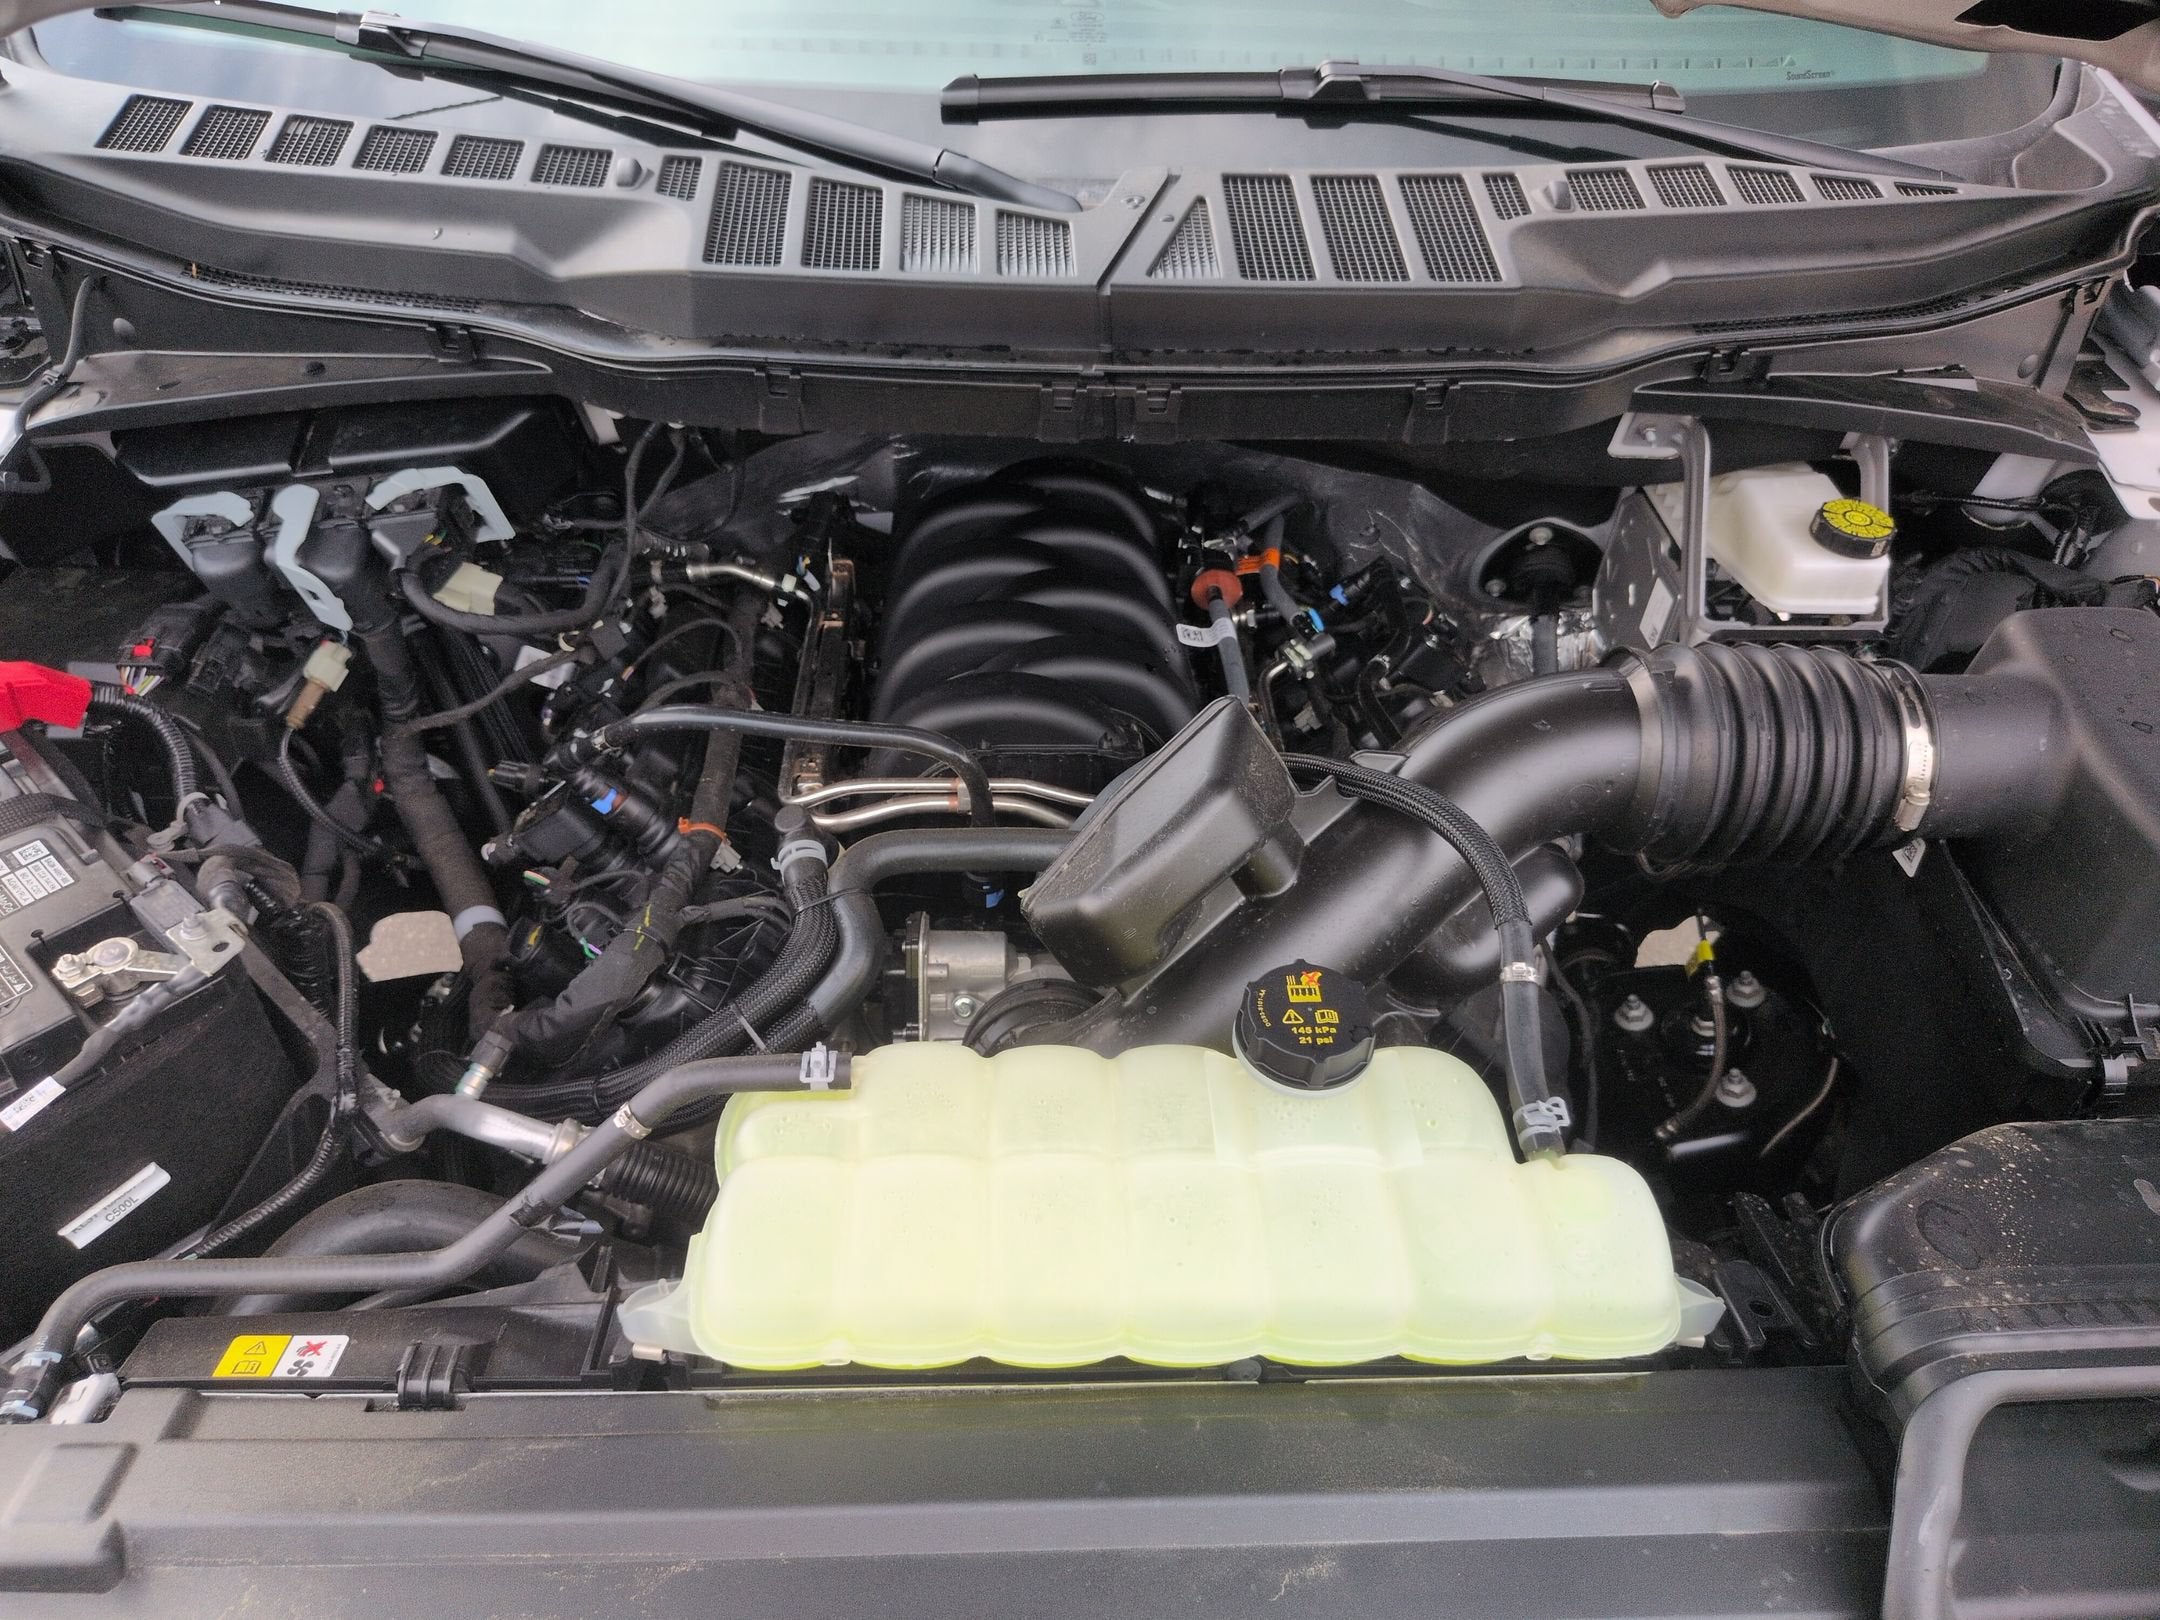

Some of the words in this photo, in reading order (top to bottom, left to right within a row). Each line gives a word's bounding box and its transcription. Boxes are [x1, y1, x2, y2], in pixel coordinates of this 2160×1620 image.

[1291, 1026, 1312, 1034] 145
[1315, 1026, 1337, 1034] kPa
[1298, 1036, 1312, 1044] 21
[1316, 1036, 1334, 1045] psi
[105, 1196, 140, 1223] C500L
